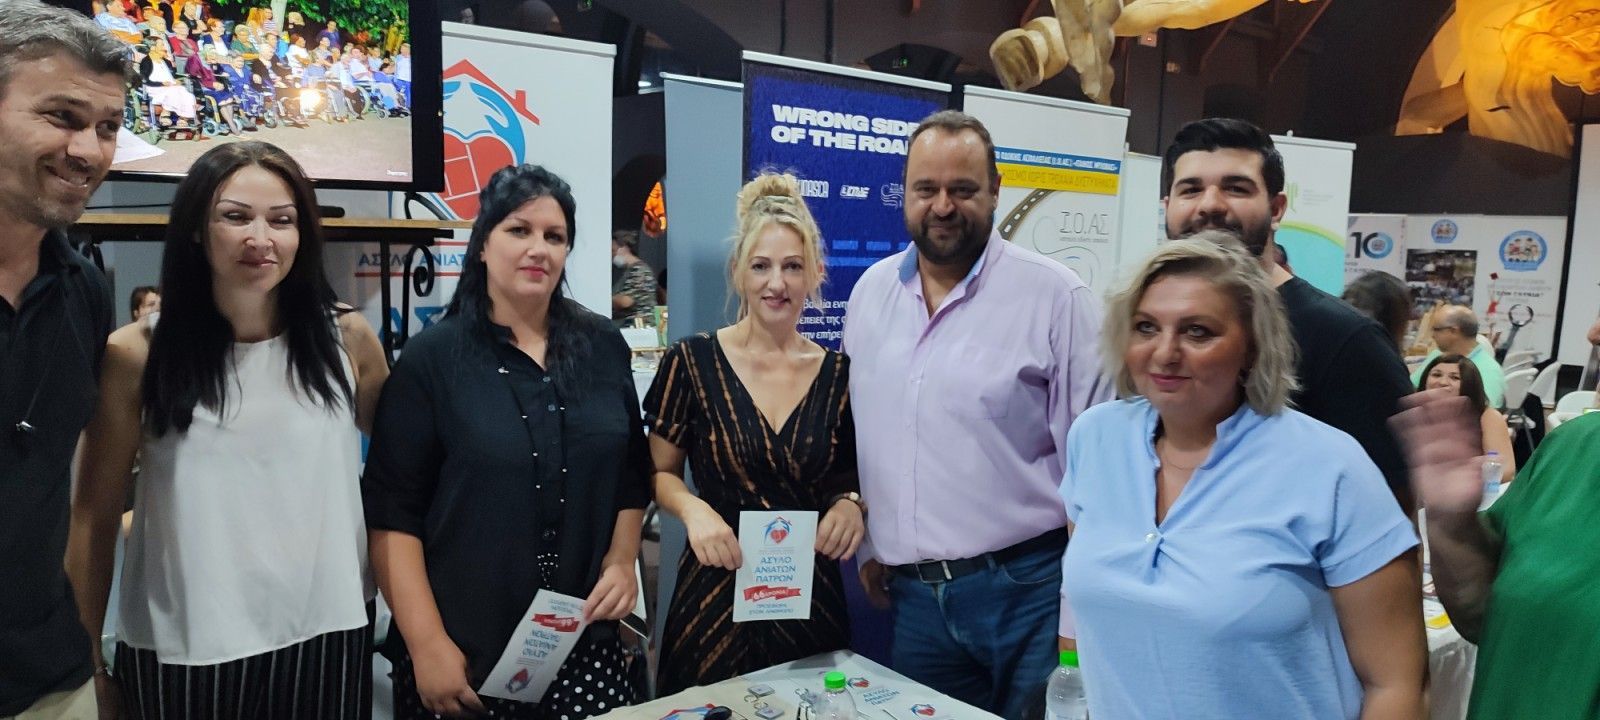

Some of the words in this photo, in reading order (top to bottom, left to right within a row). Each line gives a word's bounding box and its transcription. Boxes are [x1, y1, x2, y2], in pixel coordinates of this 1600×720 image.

[772, 104, 869, 132] WRONG
[871, 118, 920, 137] SIDE
[771, 125, 806, 144] OF
[808, 129, 856, 150] THE
[858, 135, 908, 156] ROA
